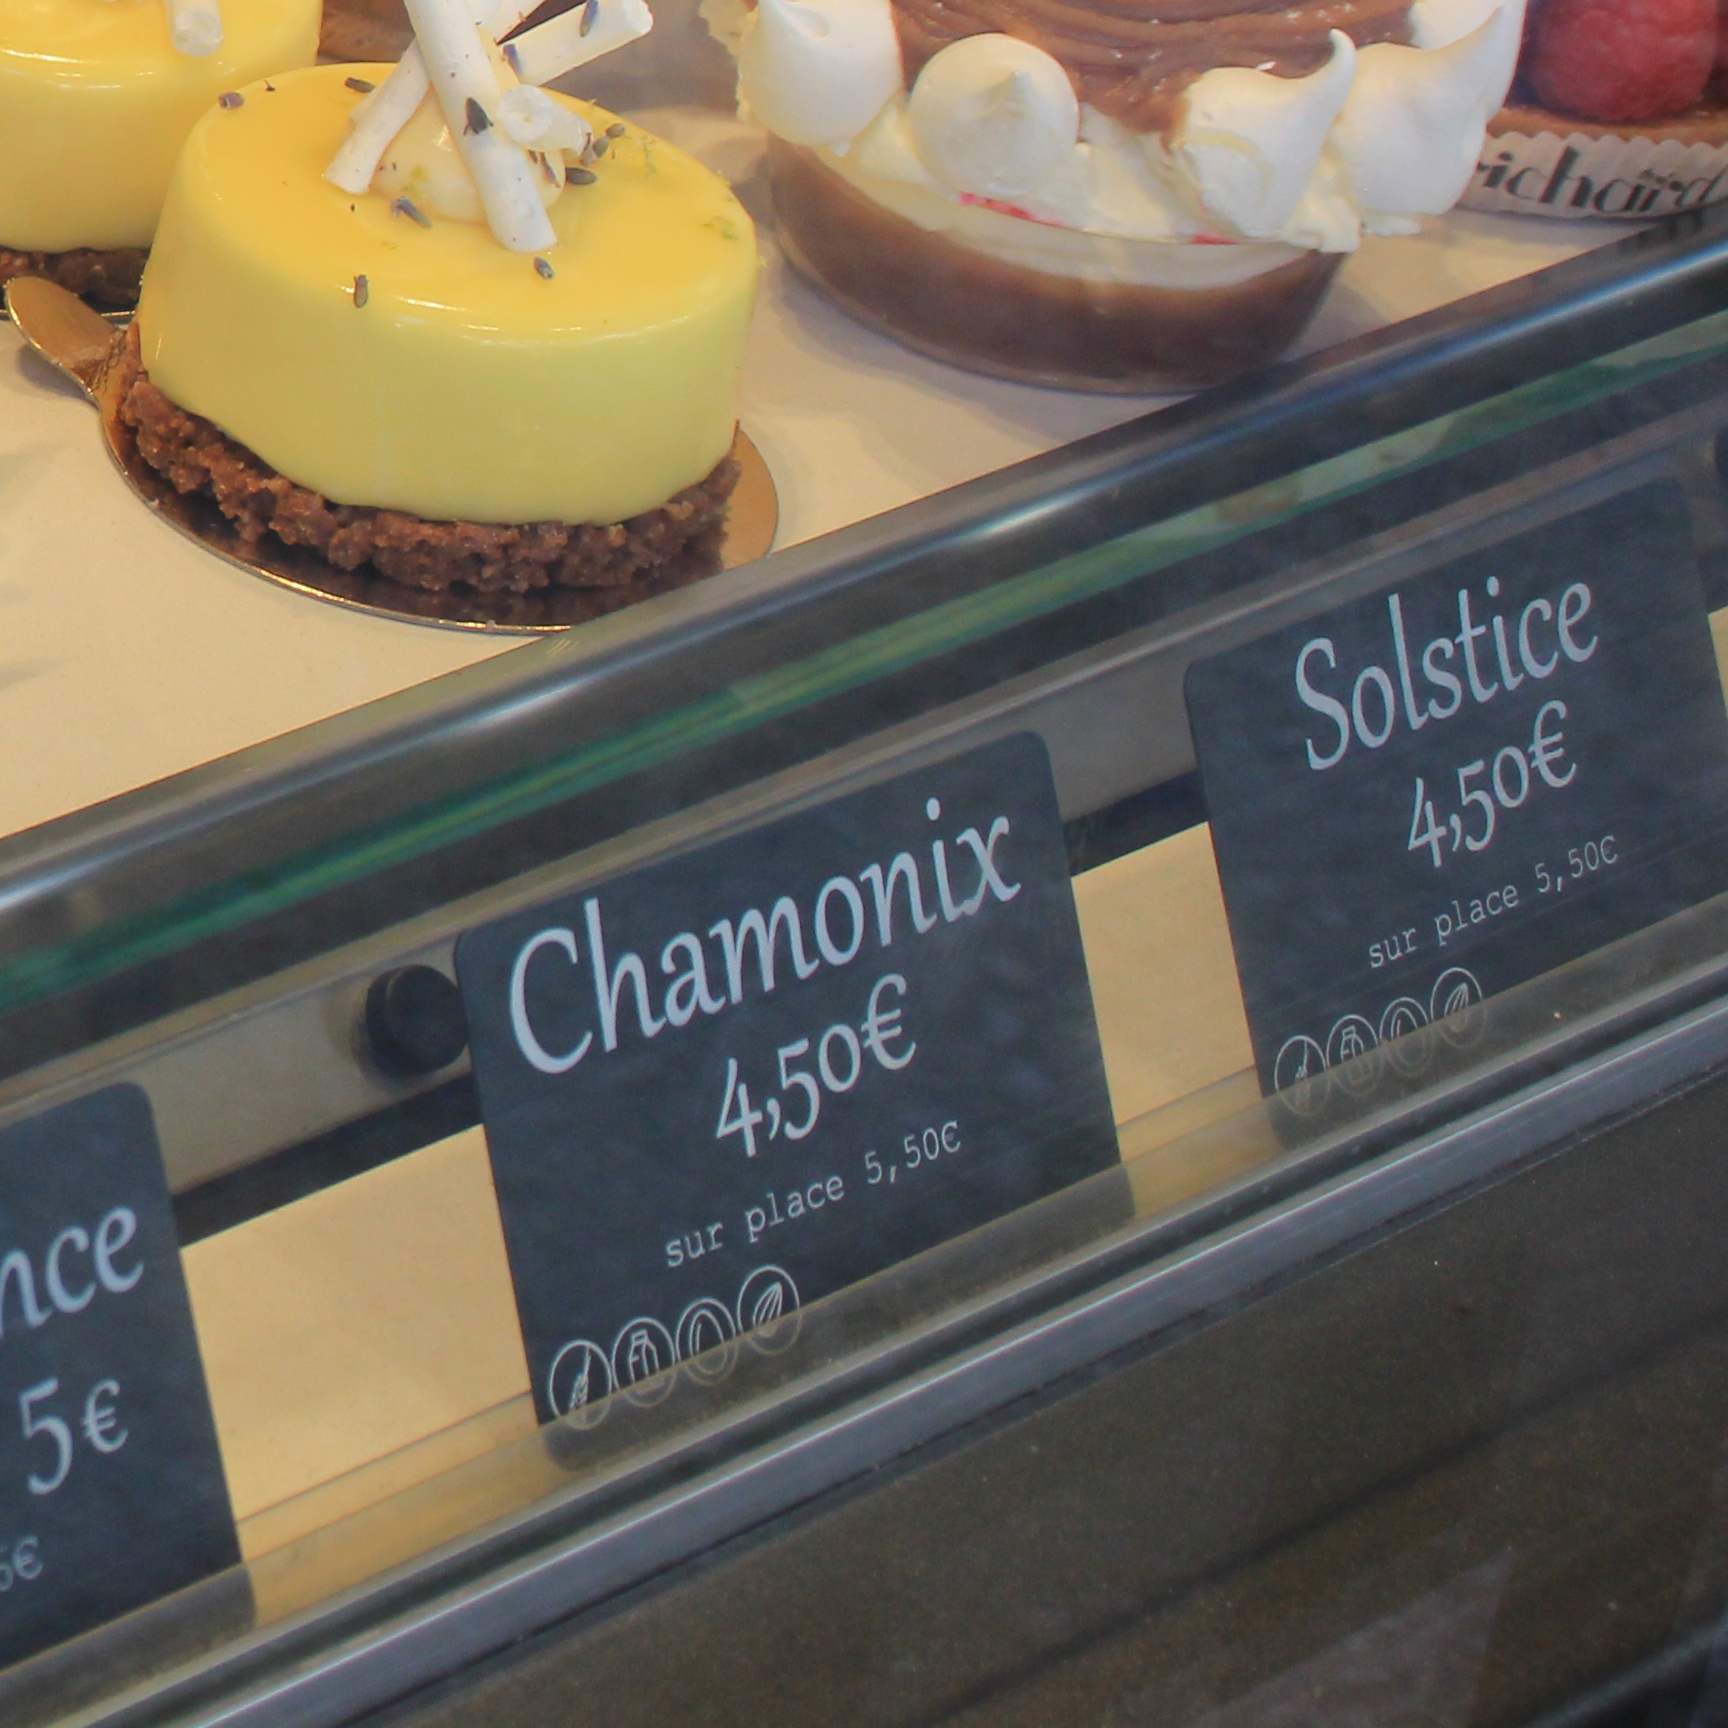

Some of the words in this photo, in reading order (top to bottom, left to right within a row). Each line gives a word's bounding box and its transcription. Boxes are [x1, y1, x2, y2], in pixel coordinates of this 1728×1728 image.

[1296, 576, 1598, 770] Solstice
[1407, 700, 1577, 868] 4,50€
[509, 797, 1022, 1073] Chamonix
[1368, 925, 1417, 968] sur
[1434, 884, 1520, 946] place
[715, 973, 917, 1158] 4,50€
[664, 1221, 724, 1267] sur
[744, 1176, 845, 1243] place
[864, 1120, 963, 1186] 5,50€
